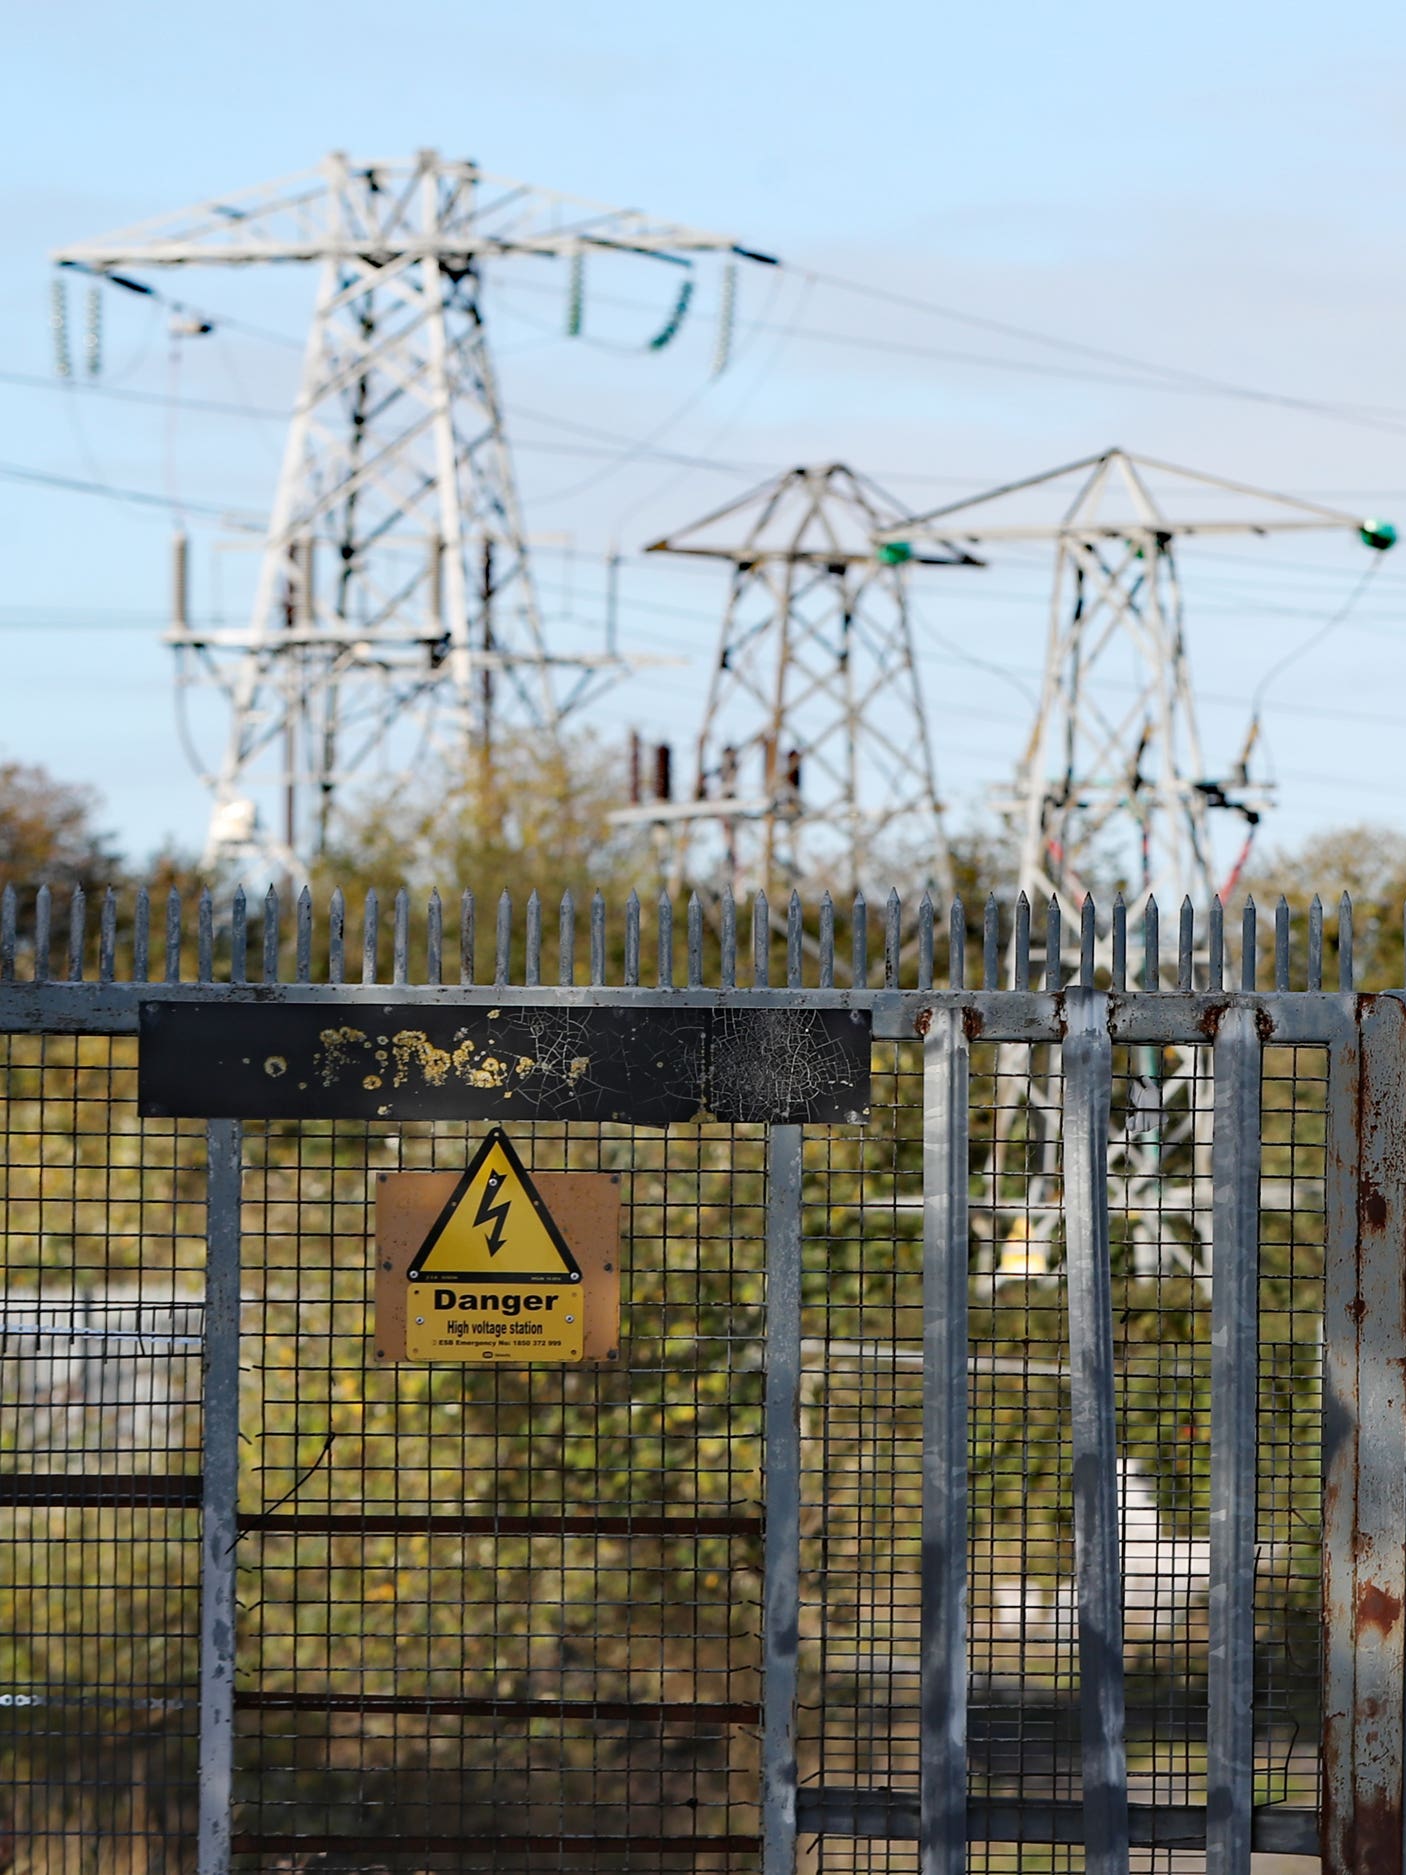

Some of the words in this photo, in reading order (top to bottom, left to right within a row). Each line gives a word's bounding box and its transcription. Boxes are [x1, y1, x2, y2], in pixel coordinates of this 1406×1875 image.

[434, 1289, 559, 1316] Danger
[447, 1320, 470, 1337] High
[472, 1321, 507, 1338] voltage
[509, 1322, 543, 1335] station
[456, 1339, 496, 1347] Emergency
